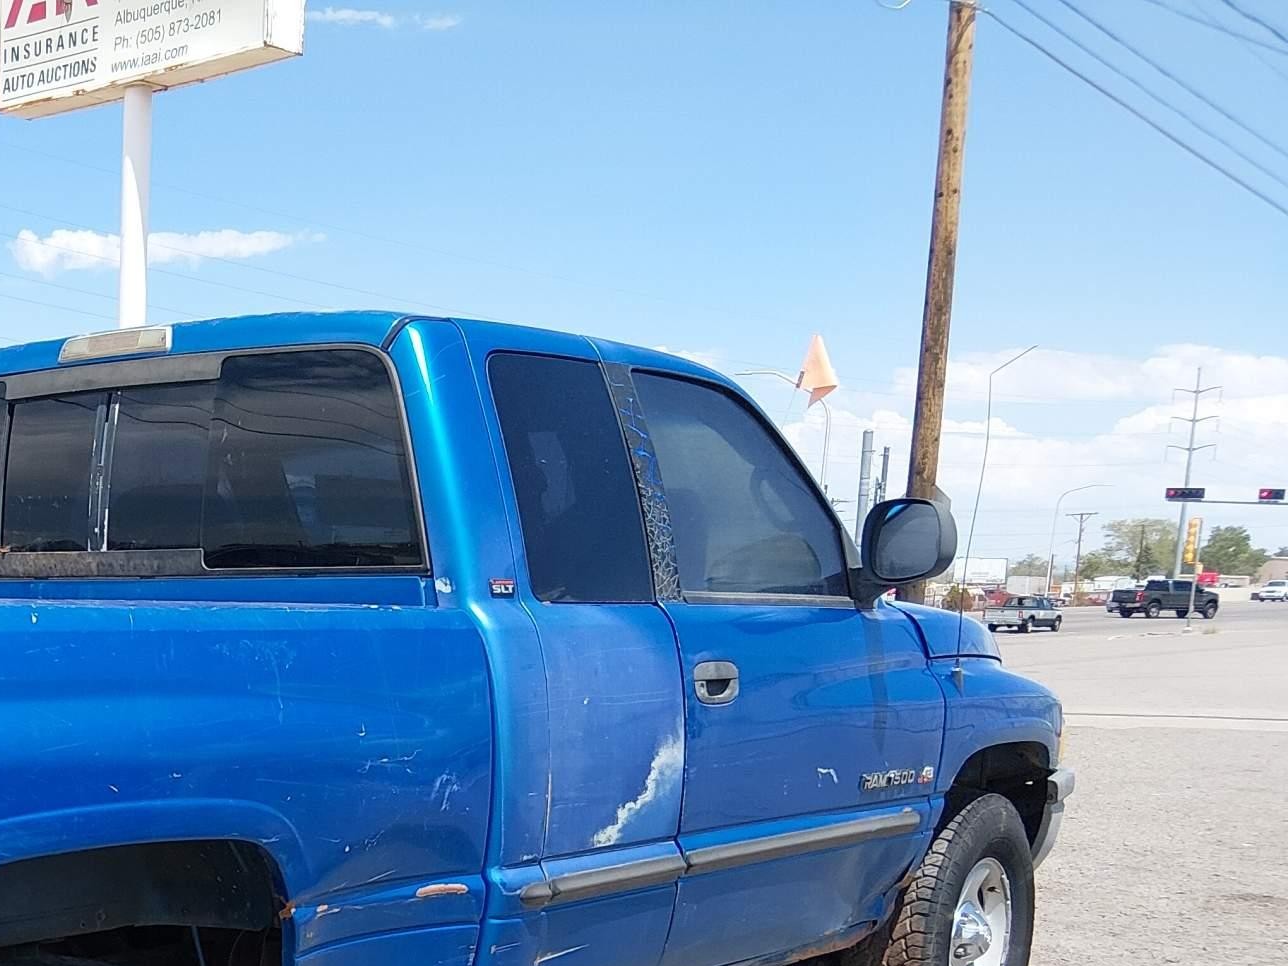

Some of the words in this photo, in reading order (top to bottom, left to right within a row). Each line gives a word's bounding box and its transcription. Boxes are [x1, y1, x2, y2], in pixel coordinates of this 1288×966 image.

[114, 0, 187, 26] Albuquerque,
[114, 35, 132, 50] Ph:
[136, 24, 165, 48] (505)
[168, 8, 221, 37] 873-2081
[4, 25, 99, 64] INSURANCE
[111, 44, 188, 73] www.iaai.com
[3, 72, 34, 94] AUTO
[37, 57, 97, 86] AUCTIONS
[492, 584, 514, 594] SLT
